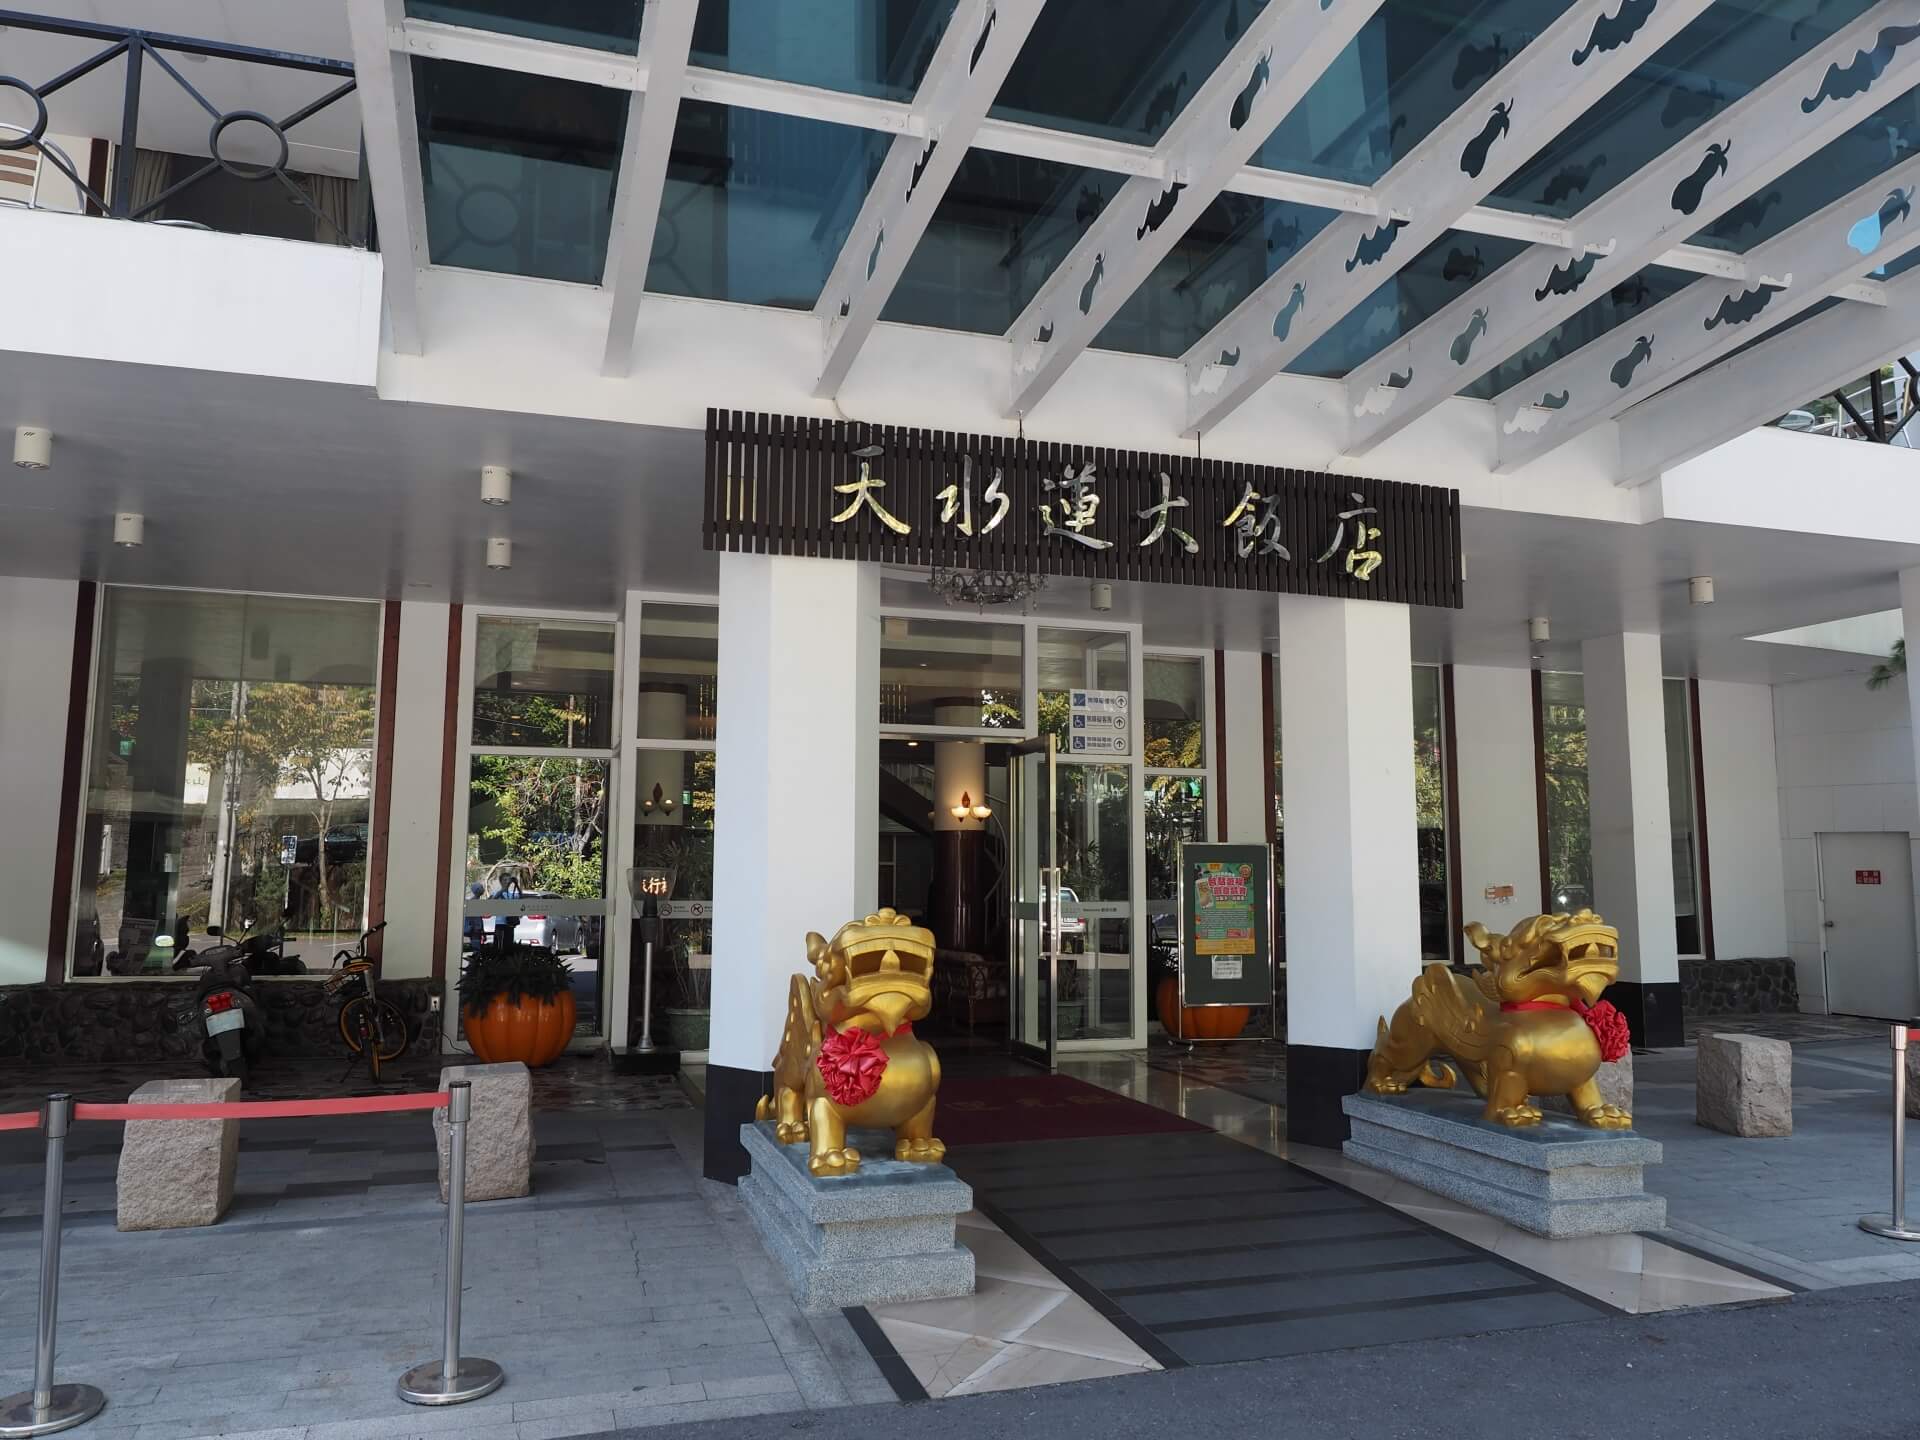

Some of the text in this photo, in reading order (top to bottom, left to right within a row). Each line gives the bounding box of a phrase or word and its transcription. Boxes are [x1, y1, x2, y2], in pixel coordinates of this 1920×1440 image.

[831, 445, 1382, 580] 天水蓮大飯店
